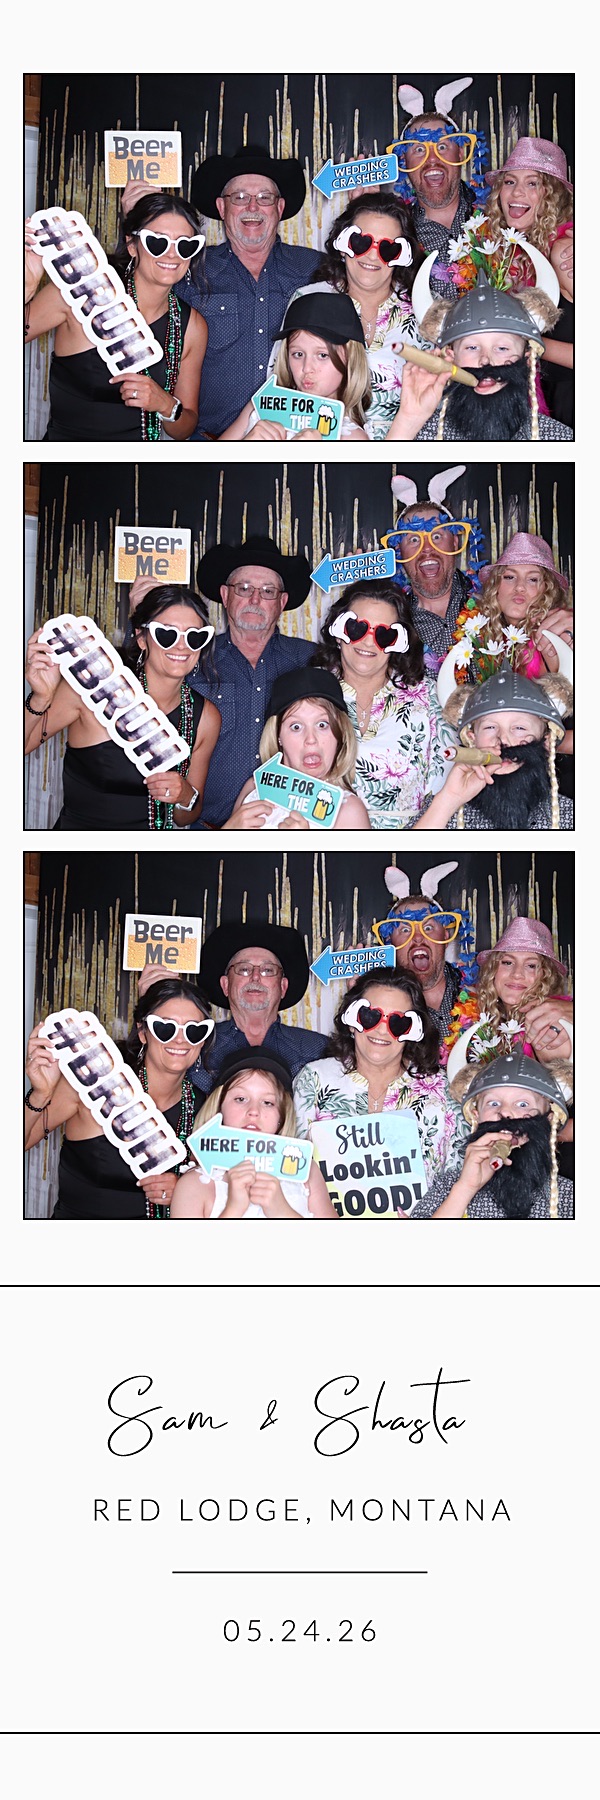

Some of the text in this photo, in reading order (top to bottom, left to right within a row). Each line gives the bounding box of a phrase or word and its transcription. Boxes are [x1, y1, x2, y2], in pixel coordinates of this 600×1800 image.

[113, 136, 173, 159] Beer
[127, 159, 160, 180] Me
[332, 169, 390, 188] CRASHERS
[334, 159, 388, 178] WEDDING
[34, 216, 154, 371] #BRUH
[260, 396, 315, 413] HERE FOR
[289, 414, 312, 429] THE
[123, 532, 183, 555] Beer
[136, 555, 169, 577] Me
[330, 564, 387, 583] CRASHERS
[332, 553, 386, 572] WEDDING
[47, 623, 181, 771] #BRUH
[260, 772, 315, 796] HERE FOR
[287, 794, 310, 812] THE
[134, 920, 193, 943] Beer
[145, 943, 179, 965] Me
[332, 949, 386, 965] WEDDING
[47, 1017, 178, 1173] #BRUH
[200, 1138, 276, 1154] HERE FOR
[335, 1122, 385, 1155] Still
[318, 1149, 417, 1182] Lookin'
